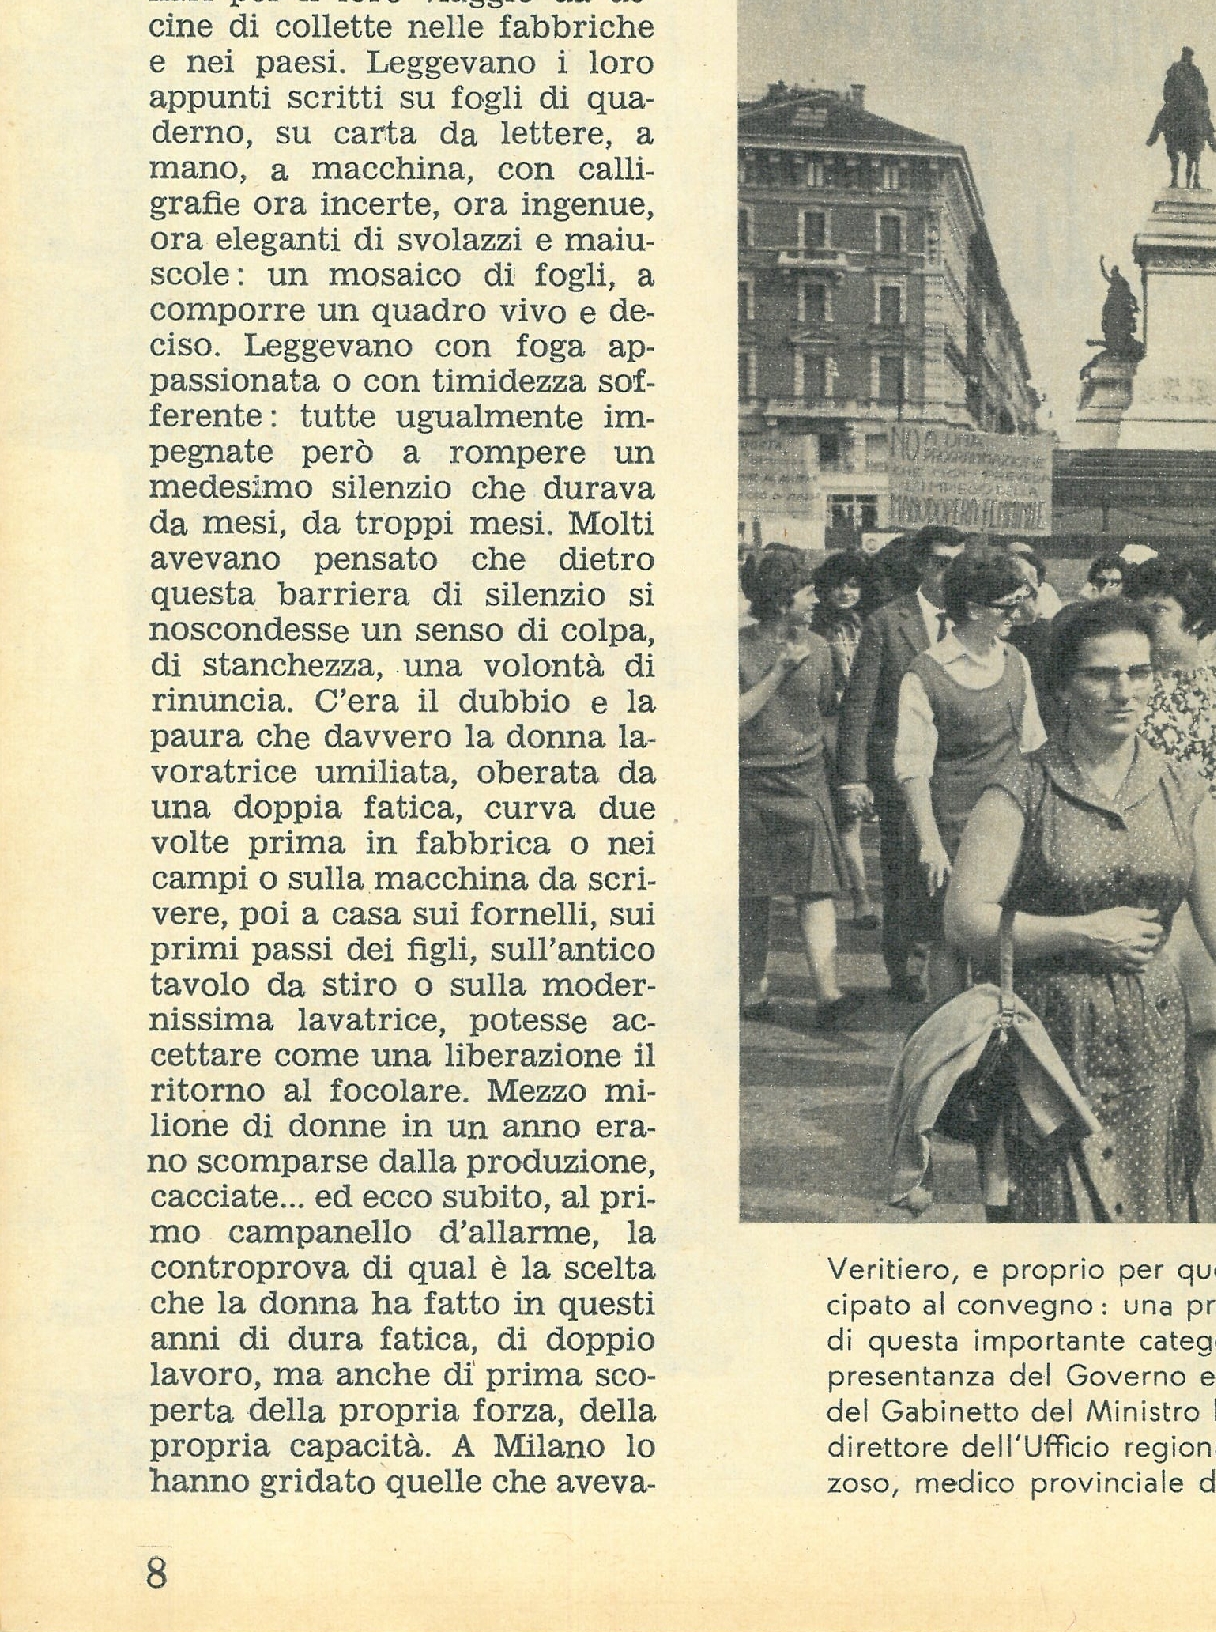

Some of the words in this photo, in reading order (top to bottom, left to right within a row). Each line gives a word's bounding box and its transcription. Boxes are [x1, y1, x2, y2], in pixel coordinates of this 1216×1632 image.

[151, 302, 305, 326] comporre
[318, 303, 359, 321] un
[372, 298, 485, 327] quadro
[500, 298, 566, 324] vivo
[580, 306, 596, 324] e
[610, 298, 654, 322] de-
[890, 426, 920, 461] NO
[150, 729, 243, 752] paura
[257, 724, 310, 750] che
[325, 724, 451, 748] davvero
[465, 724, 494, 748] la
[507, 724, 606, 748] donna
[619, 724, 655, 748] la-
[150, 936, 238, 966] primi
[252, 936, 333, 966] passi
[348, 936, 394, 962] dei
[407, 936, 476, 966] figli,
[492, 937, 655, 961] sull'antico
[151, 1042, 261, 1066] cettare
[275, 1048, 359, 1067] come
[372, 1049, 431, 1067] una
[445, 1042, 620, 1068] liberazione
[635, 1042, 655, 1067] il
[827, 1257, 958, 1284] Veritiero,
[974, 1264, 988, 1279] e
[1003, 1258, 1104, 1286] proprio
[1120, 1264, 1163, 1286] per
[150, 1433, 270, 1462] propria
[291, 1433, 430, 1462] capacità.
[452, 1434, 475, 1457] A
[494, 1434, 605, 1458] Milano
[626, 1434, 654, 1457] lo
[149, 1467, 249, 1492] hanno
[261, 1468, 375, 1498] gridato
[386, 1468, 481, 1498] quelle
[493, 1469, 546, 1494] che
[557, 1475, 655, 1494] aveva-
[828, 1478, 898, 1498] zoso,
[916, 1469, 1014, 1493] medico
[1032, 1469, 1183, 1498] provinciale
[147, 1557, 167, 1589] 8
